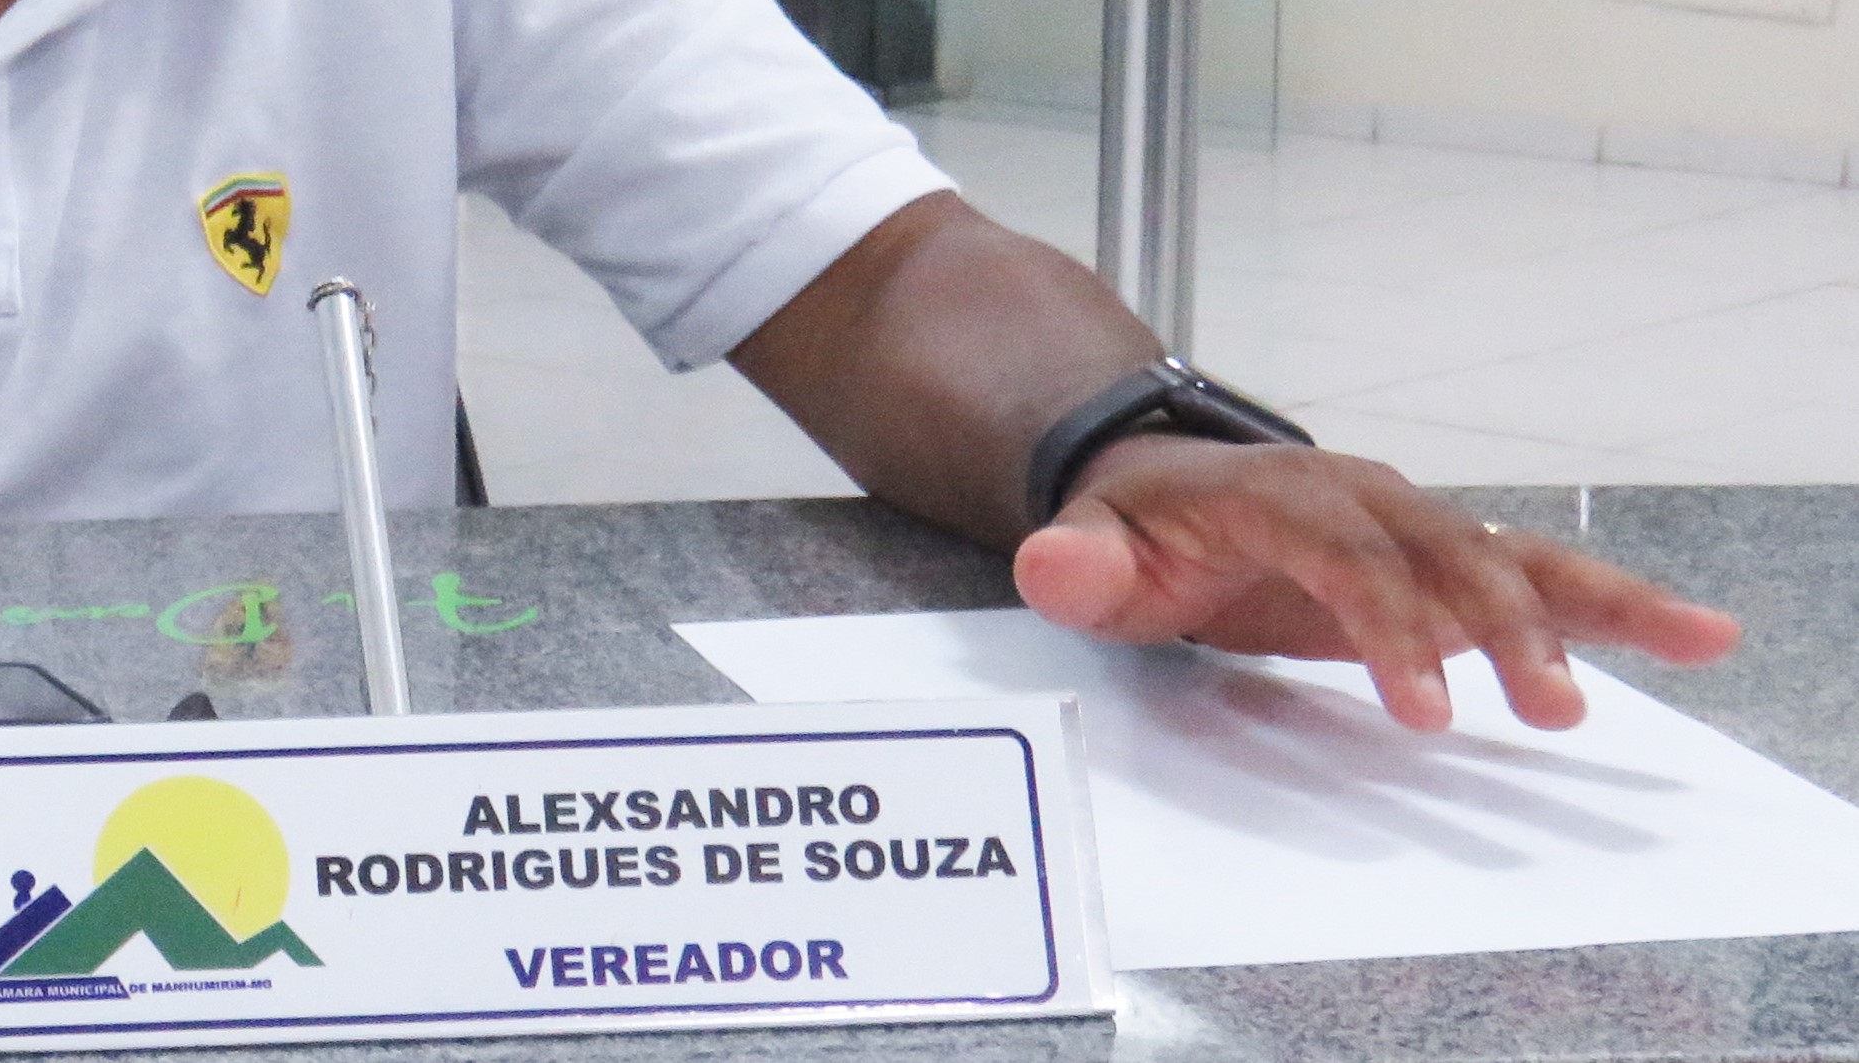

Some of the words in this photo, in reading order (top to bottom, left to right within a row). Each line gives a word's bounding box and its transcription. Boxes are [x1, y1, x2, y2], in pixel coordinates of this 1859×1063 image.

[462, 783, 881, 837] ALEXSANDRO
[315, 844, 683, 898] RODRIGUES
[702, 841, 784, 886] DE
[803, 835, 1018, 883] SOUZA
[46, 984, 126, 998] MUNICIPAL
[129, 983, 147, 994] DE
[503, 938, 849, 991] VEREADOR
